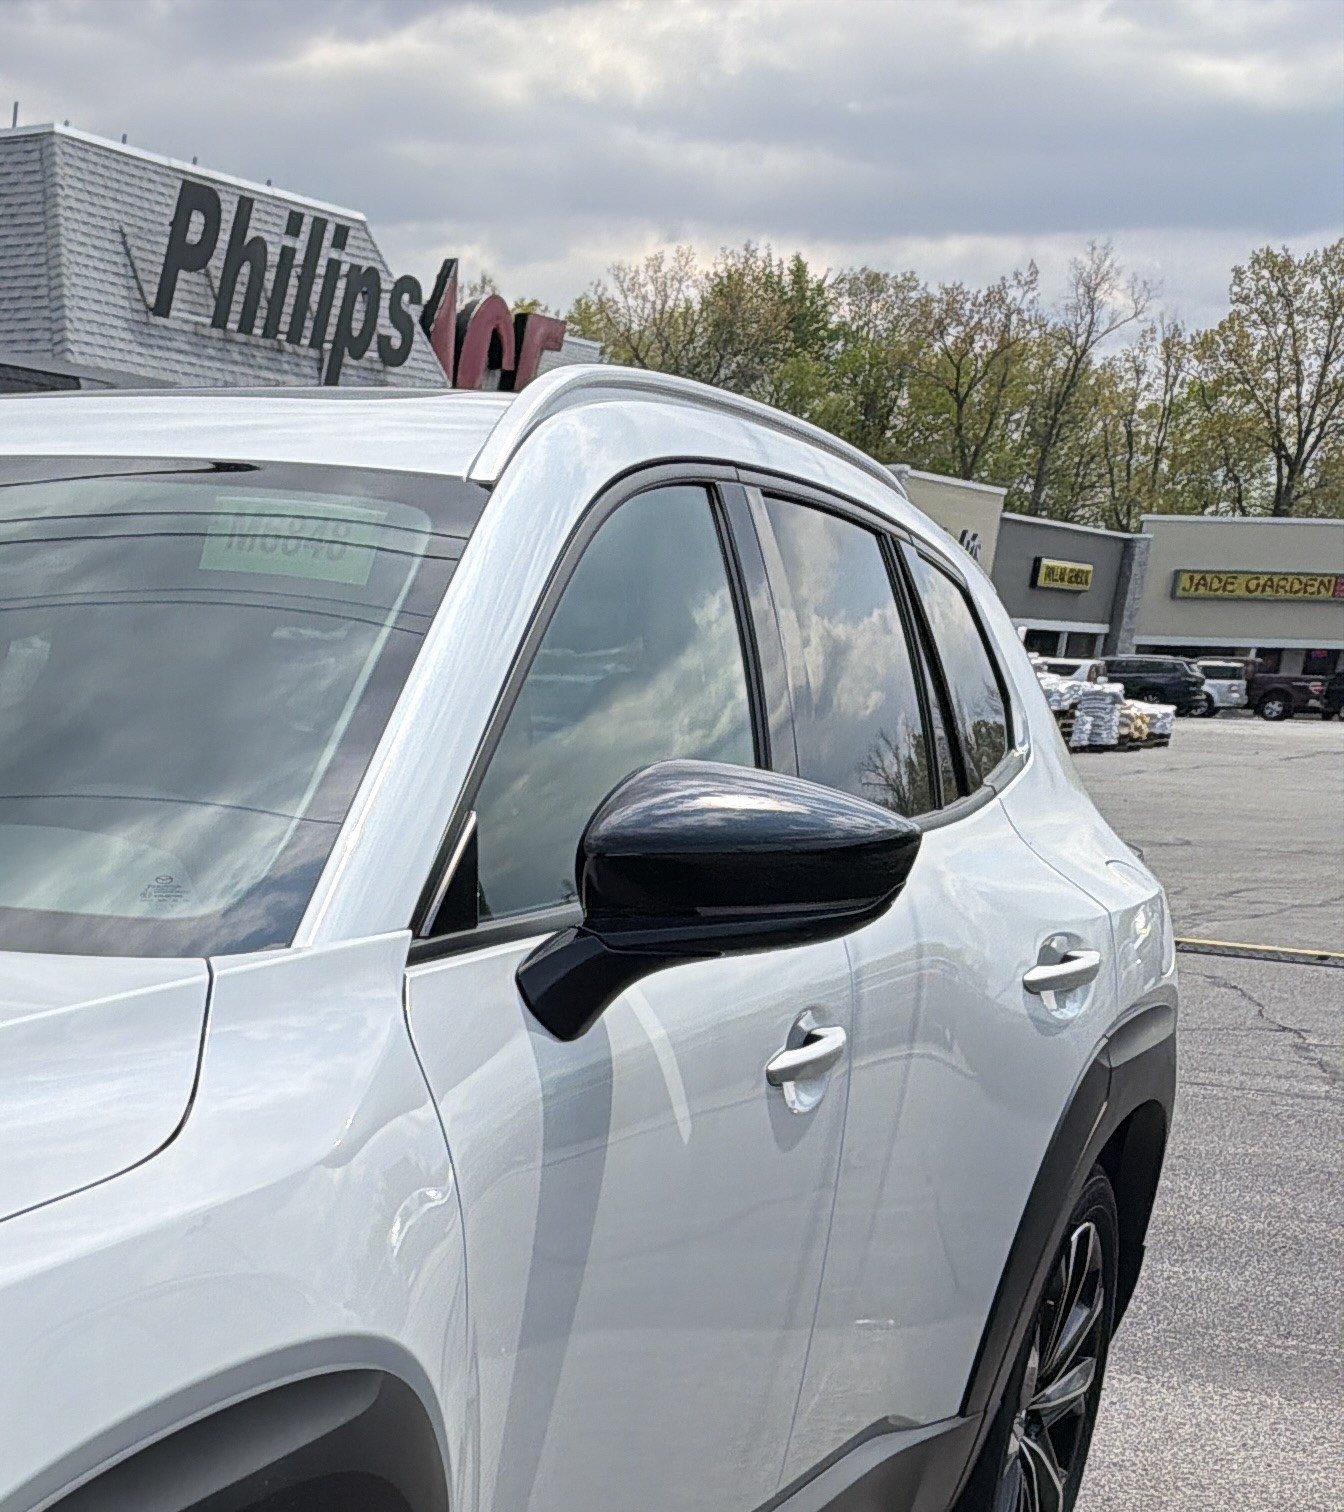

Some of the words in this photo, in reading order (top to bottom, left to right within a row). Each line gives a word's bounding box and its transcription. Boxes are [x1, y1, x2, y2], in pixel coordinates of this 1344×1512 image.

[153, 179, 422, 387] Philips
[1181, 573, 1239, 594] JADE
[1244, 575, 1333, 596] GARDEN
